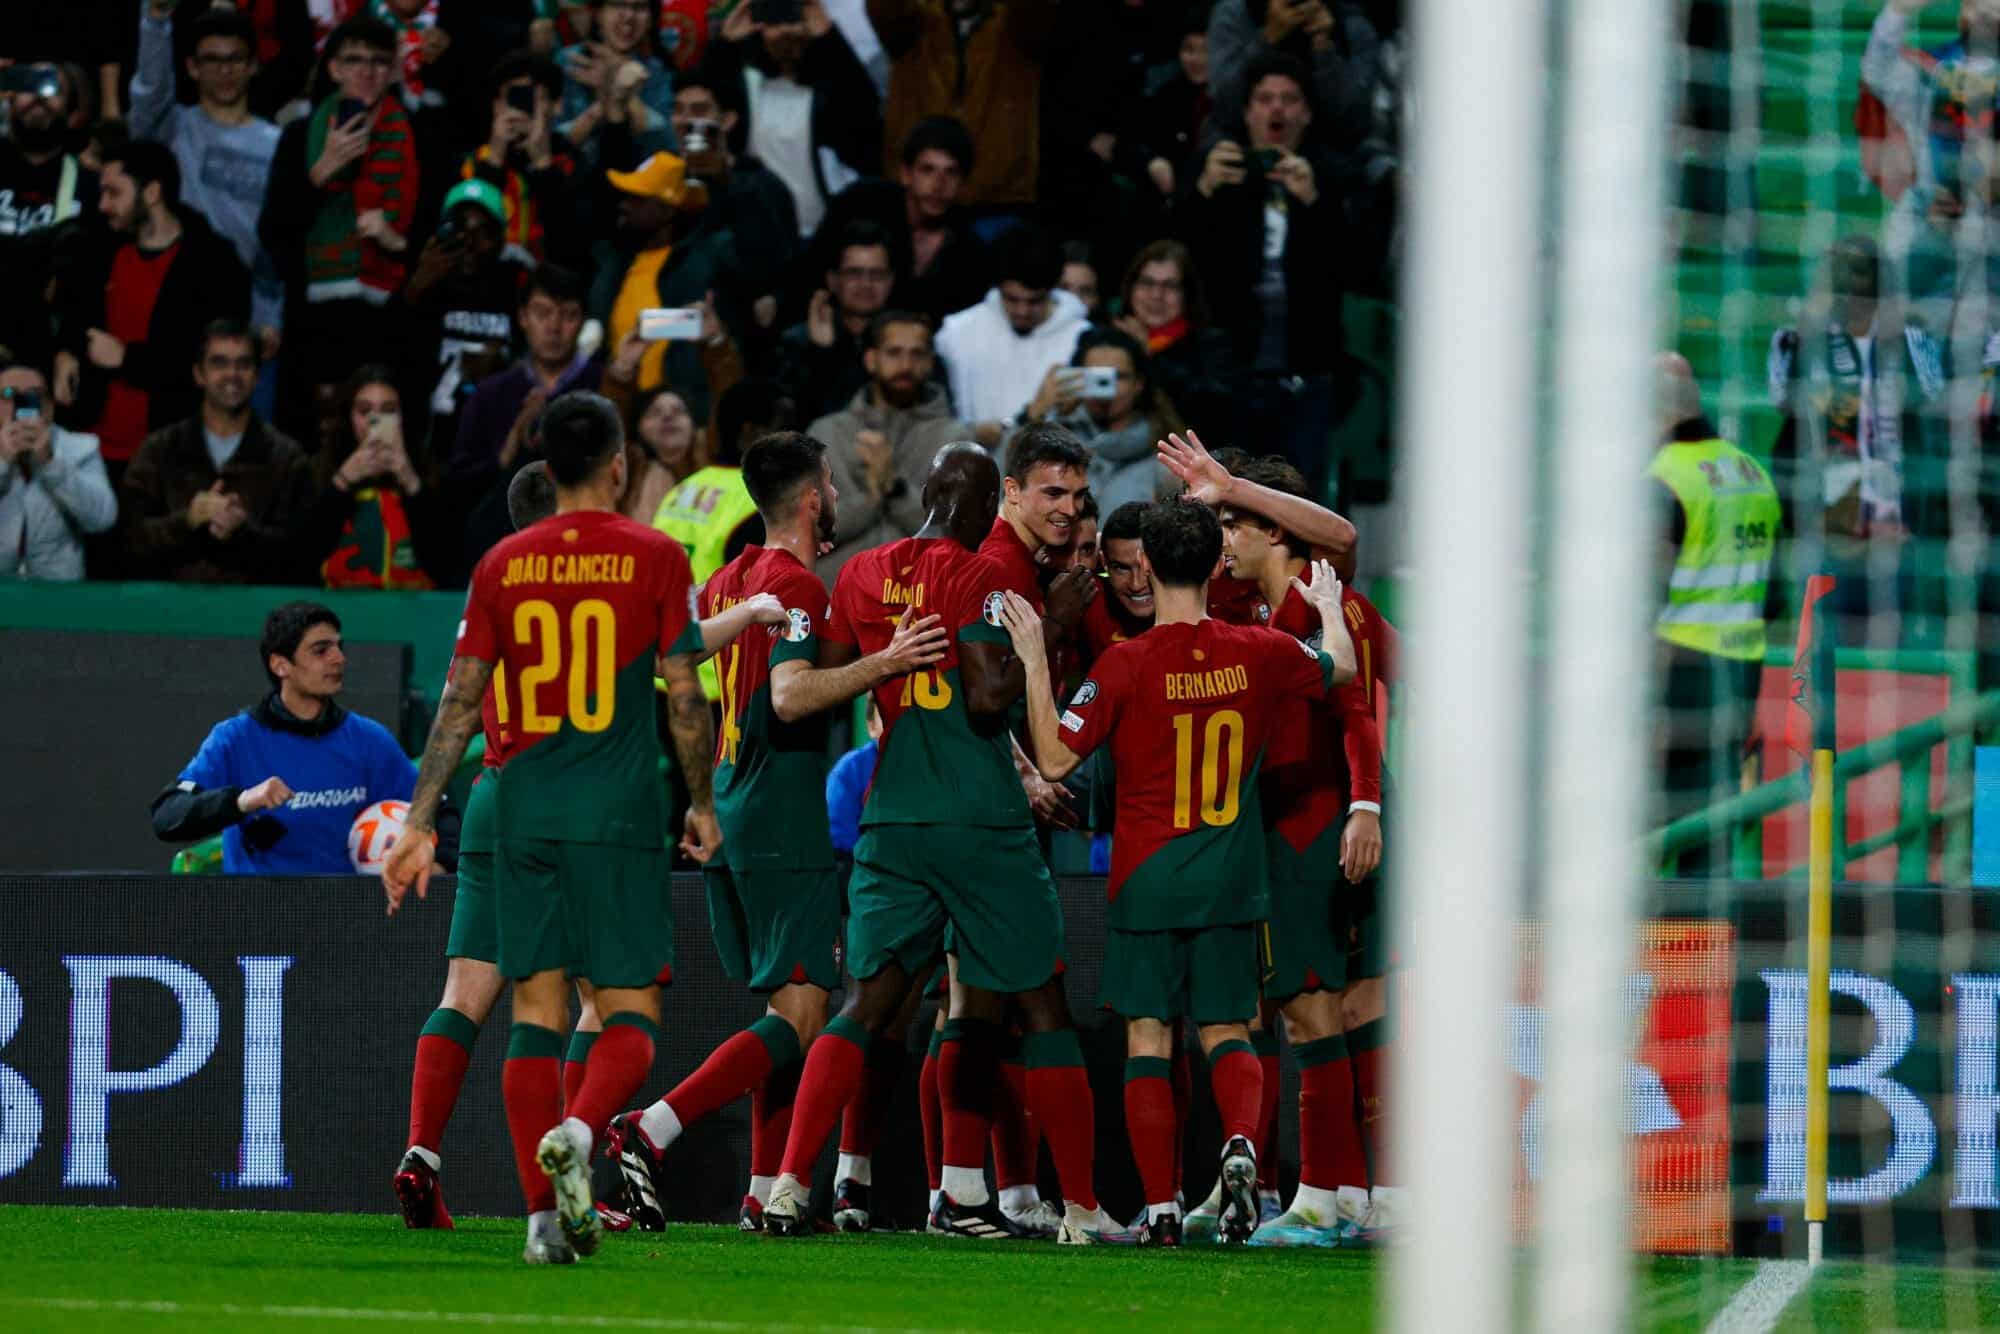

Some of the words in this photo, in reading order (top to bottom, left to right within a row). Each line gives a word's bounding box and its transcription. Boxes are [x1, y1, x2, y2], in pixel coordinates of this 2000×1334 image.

[502, 552, 548, 586] JOÃO
[552, 554, 635, 583] CANCELO
[513, 598, 616, 733] 20
[1165, 664, 1248, 701] BERNARDO
[287, 786, 368, 810] EIXAJOGAR
[1173, 709, 1244, 830] 10
[0, 954, 294, 1188] PI
